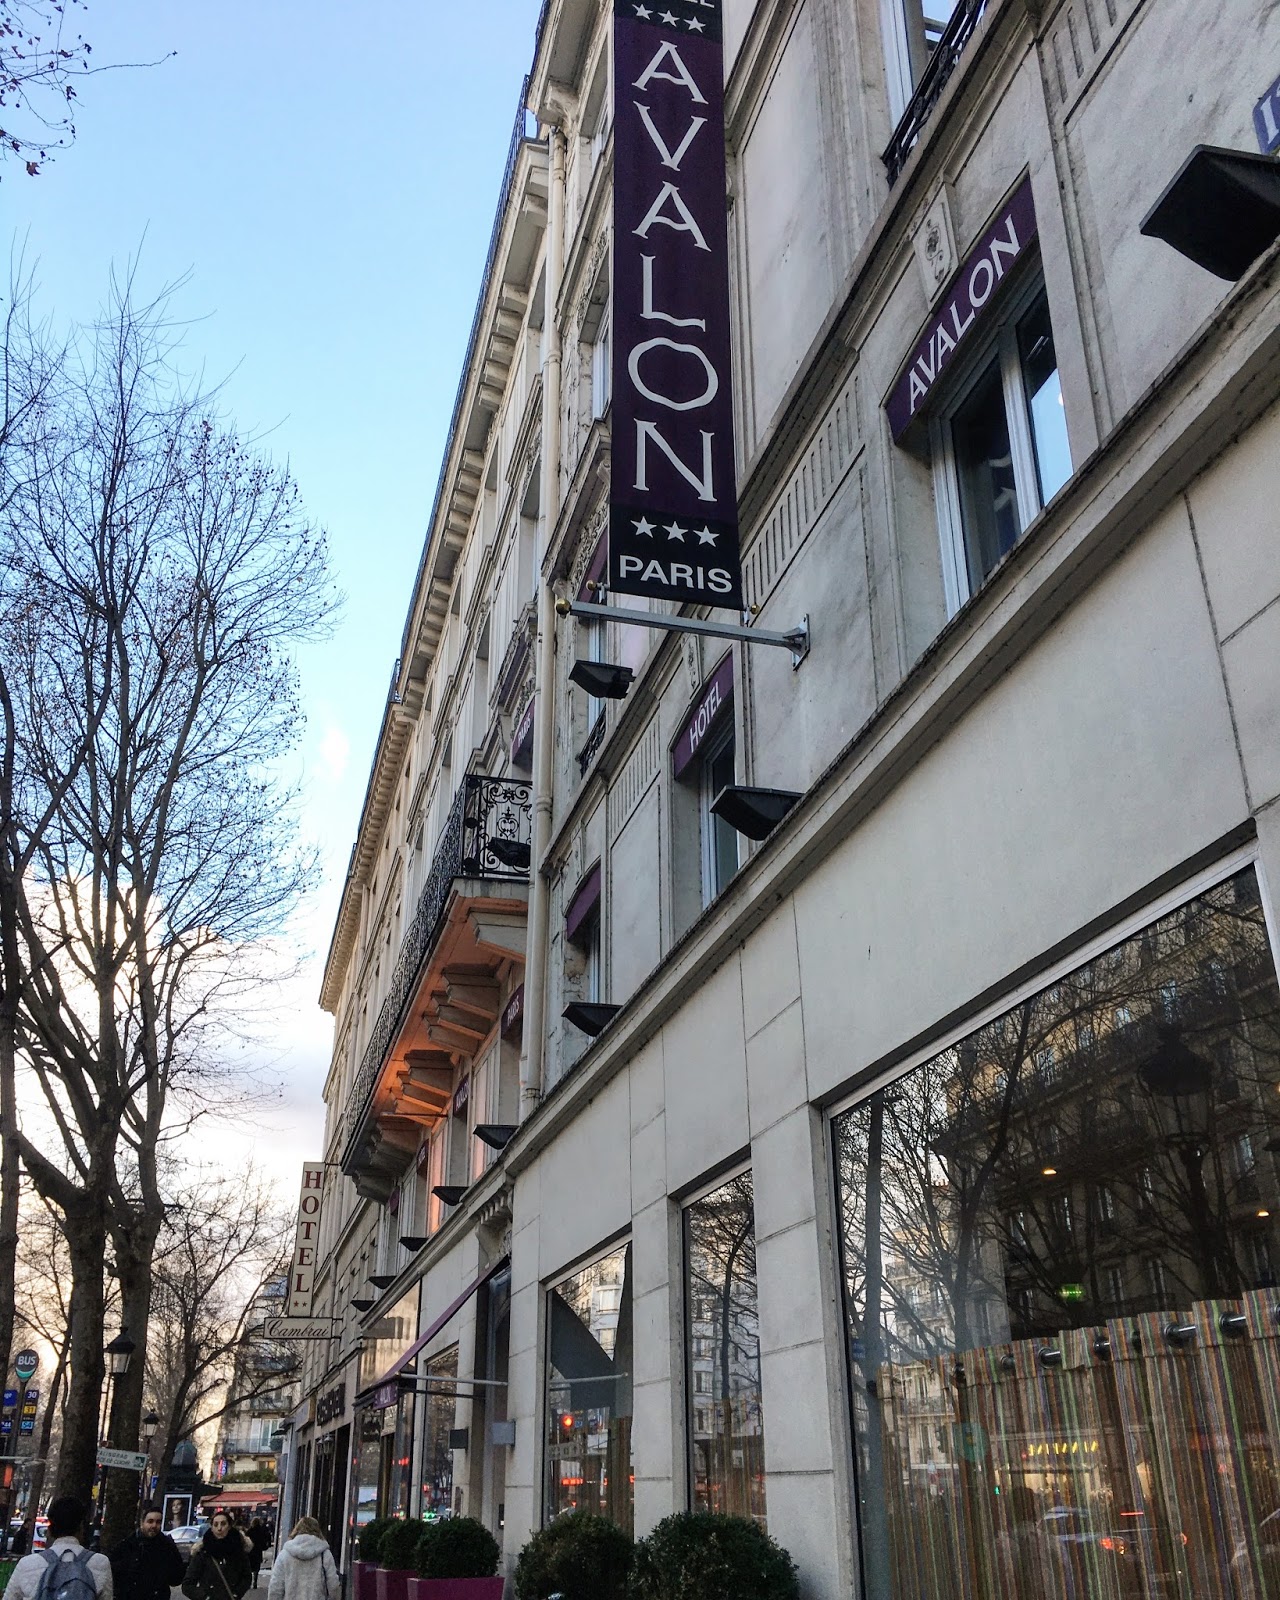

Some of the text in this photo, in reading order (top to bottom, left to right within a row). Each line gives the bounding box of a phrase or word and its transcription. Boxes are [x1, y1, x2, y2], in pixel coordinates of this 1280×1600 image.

[627, 39, 719, 502] AVALON
[909, 213, 1022, 416] AVALON
[618, 554, 733, 593] PARIS
[688, 679, 723, 753] HÔTEL
[293, 1169, 323, 1294] HOTEL
[266, 1318, 331, 1338] Cambrai
[18, 1355, 36, 1365] BUS
[27, 1391, 38, 1399] 30
